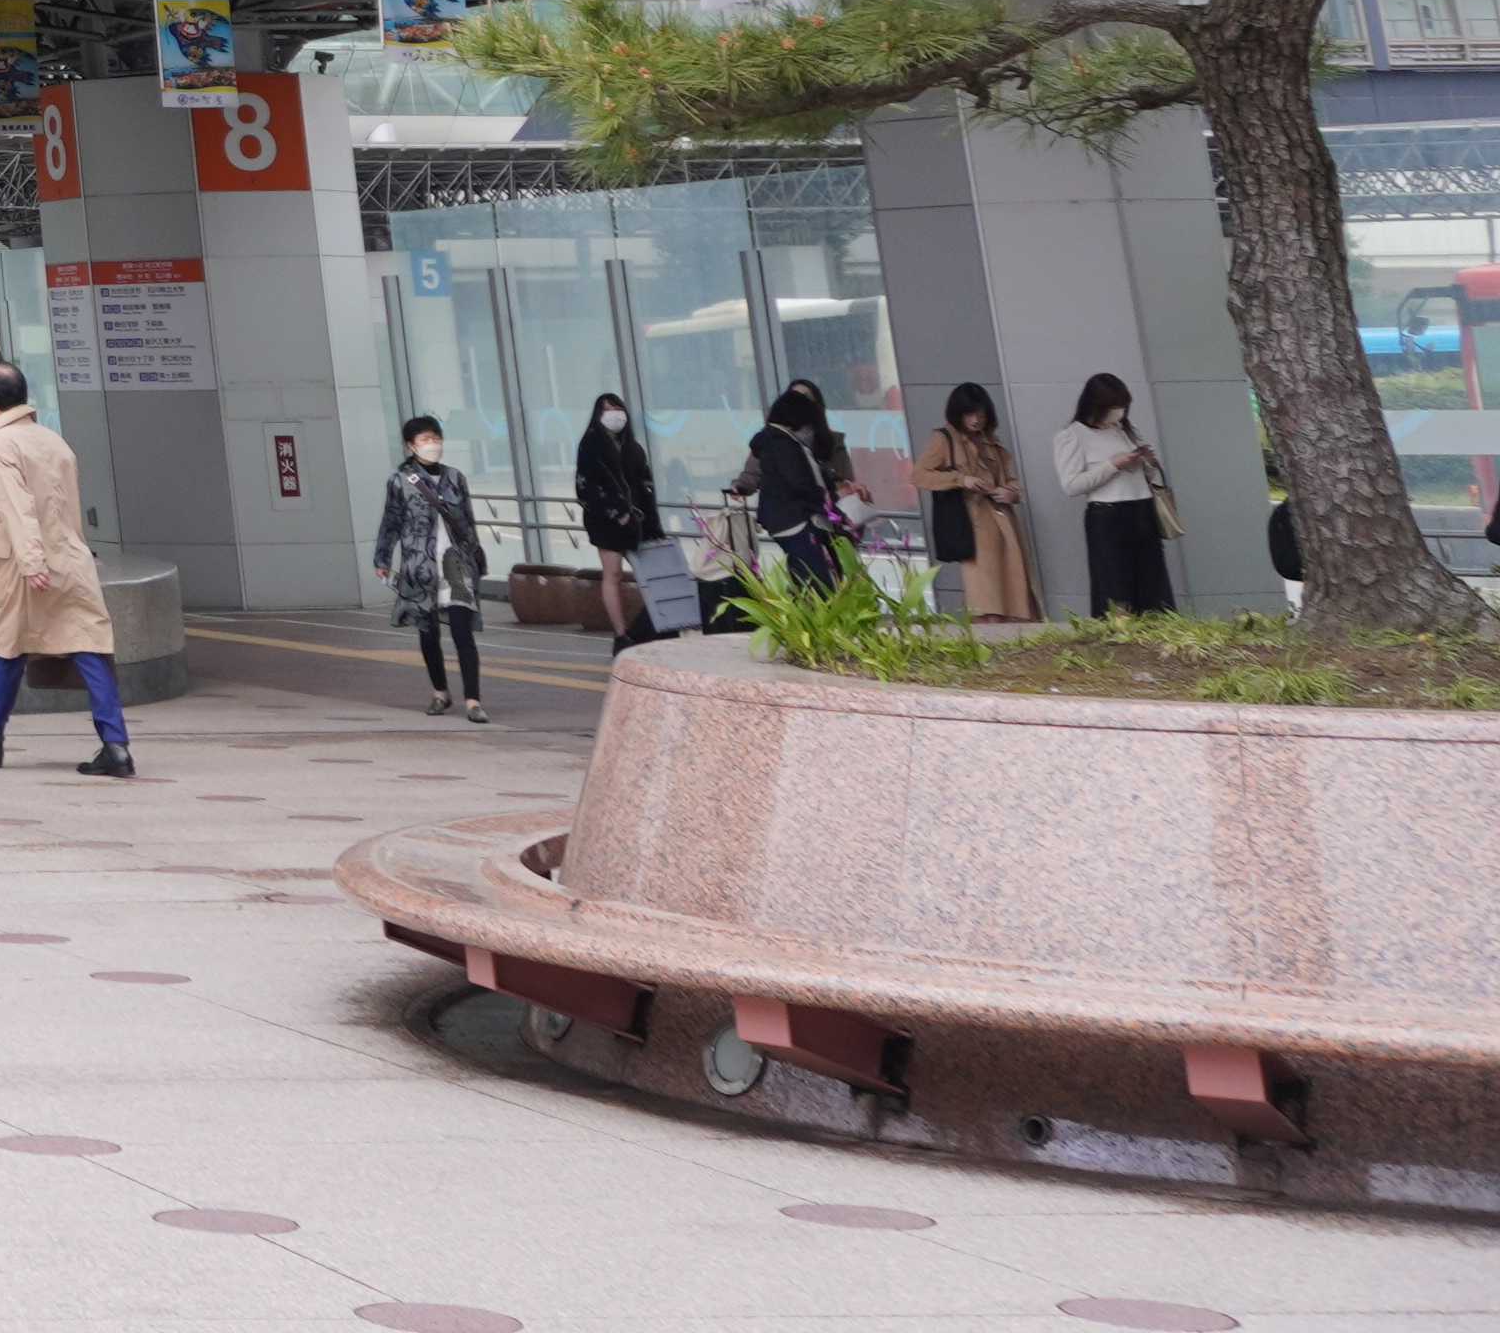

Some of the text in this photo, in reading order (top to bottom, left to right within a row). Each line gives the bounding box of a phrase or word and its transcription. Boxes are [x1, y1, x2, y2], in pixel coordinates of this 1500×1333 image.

[43, 104, 66, 181] 8
[223, 92, 277, 171] 8
[422, 258, 439, 290] 5
[278, 441, 298, 491] 消火器
